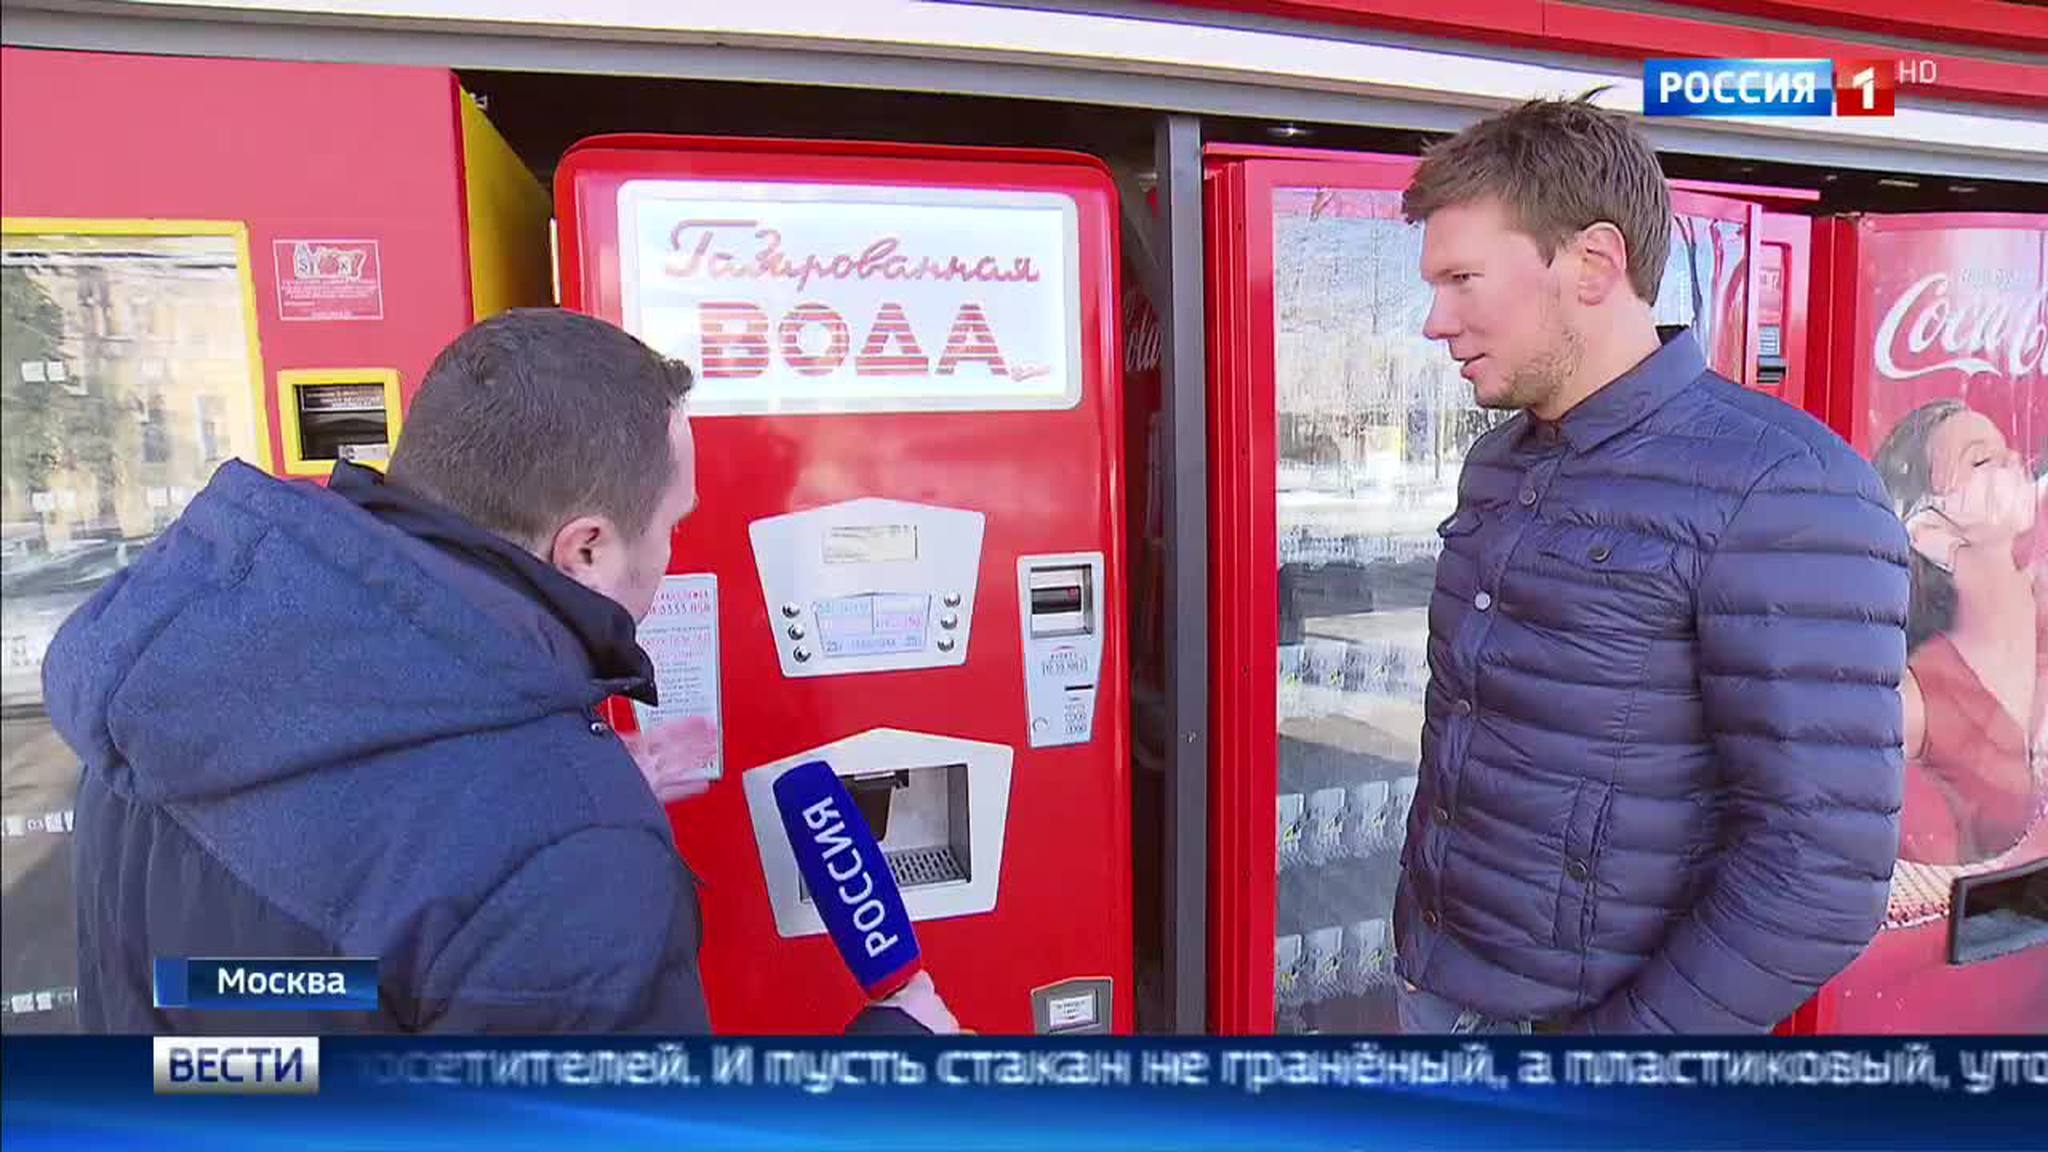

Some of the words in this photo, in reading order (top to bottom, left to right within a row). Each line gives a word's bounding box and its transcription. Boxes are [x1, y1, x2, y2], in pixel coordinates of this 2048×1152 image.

[665, 219, 1041, 292] Газированная
[700, 301, 1010, 378] ВОДА
[802, 796, 899, 958] РОССИЯ
